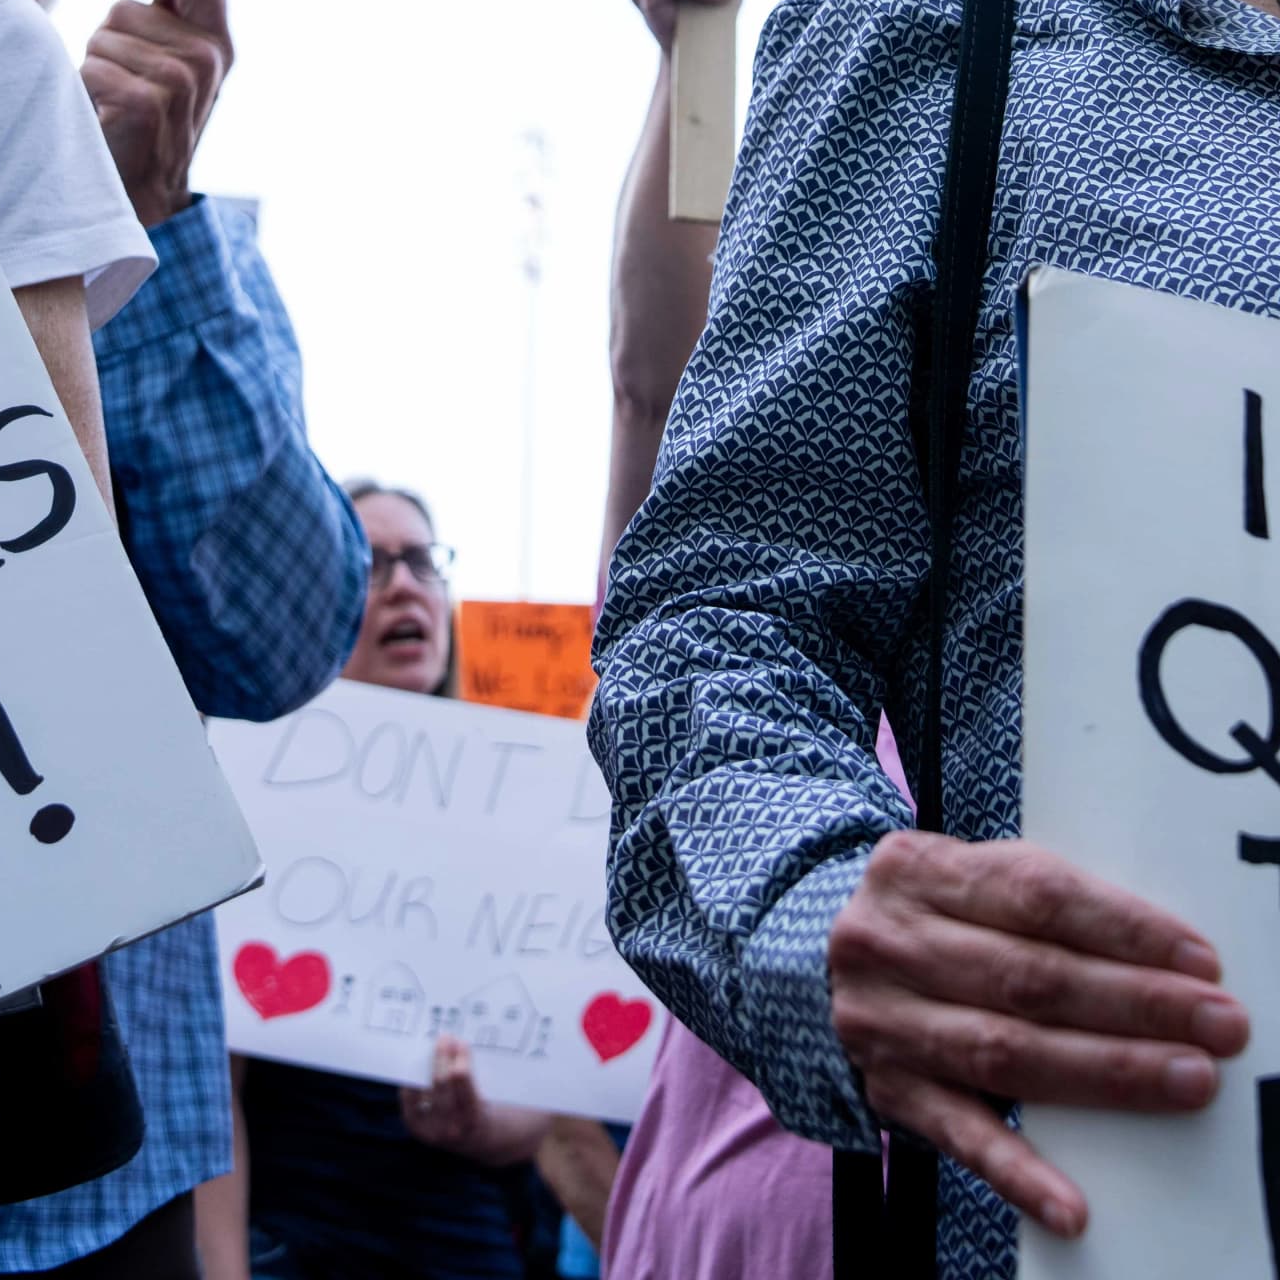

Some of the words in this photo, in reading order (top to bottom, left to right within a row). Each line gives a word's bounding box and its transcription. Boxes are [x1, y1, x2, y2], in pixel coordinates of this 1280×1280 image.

[1243, 388, 1270, 539] I
[273, 855, 438, 939] OUR
[466, 892, 613, 956] NEIG
